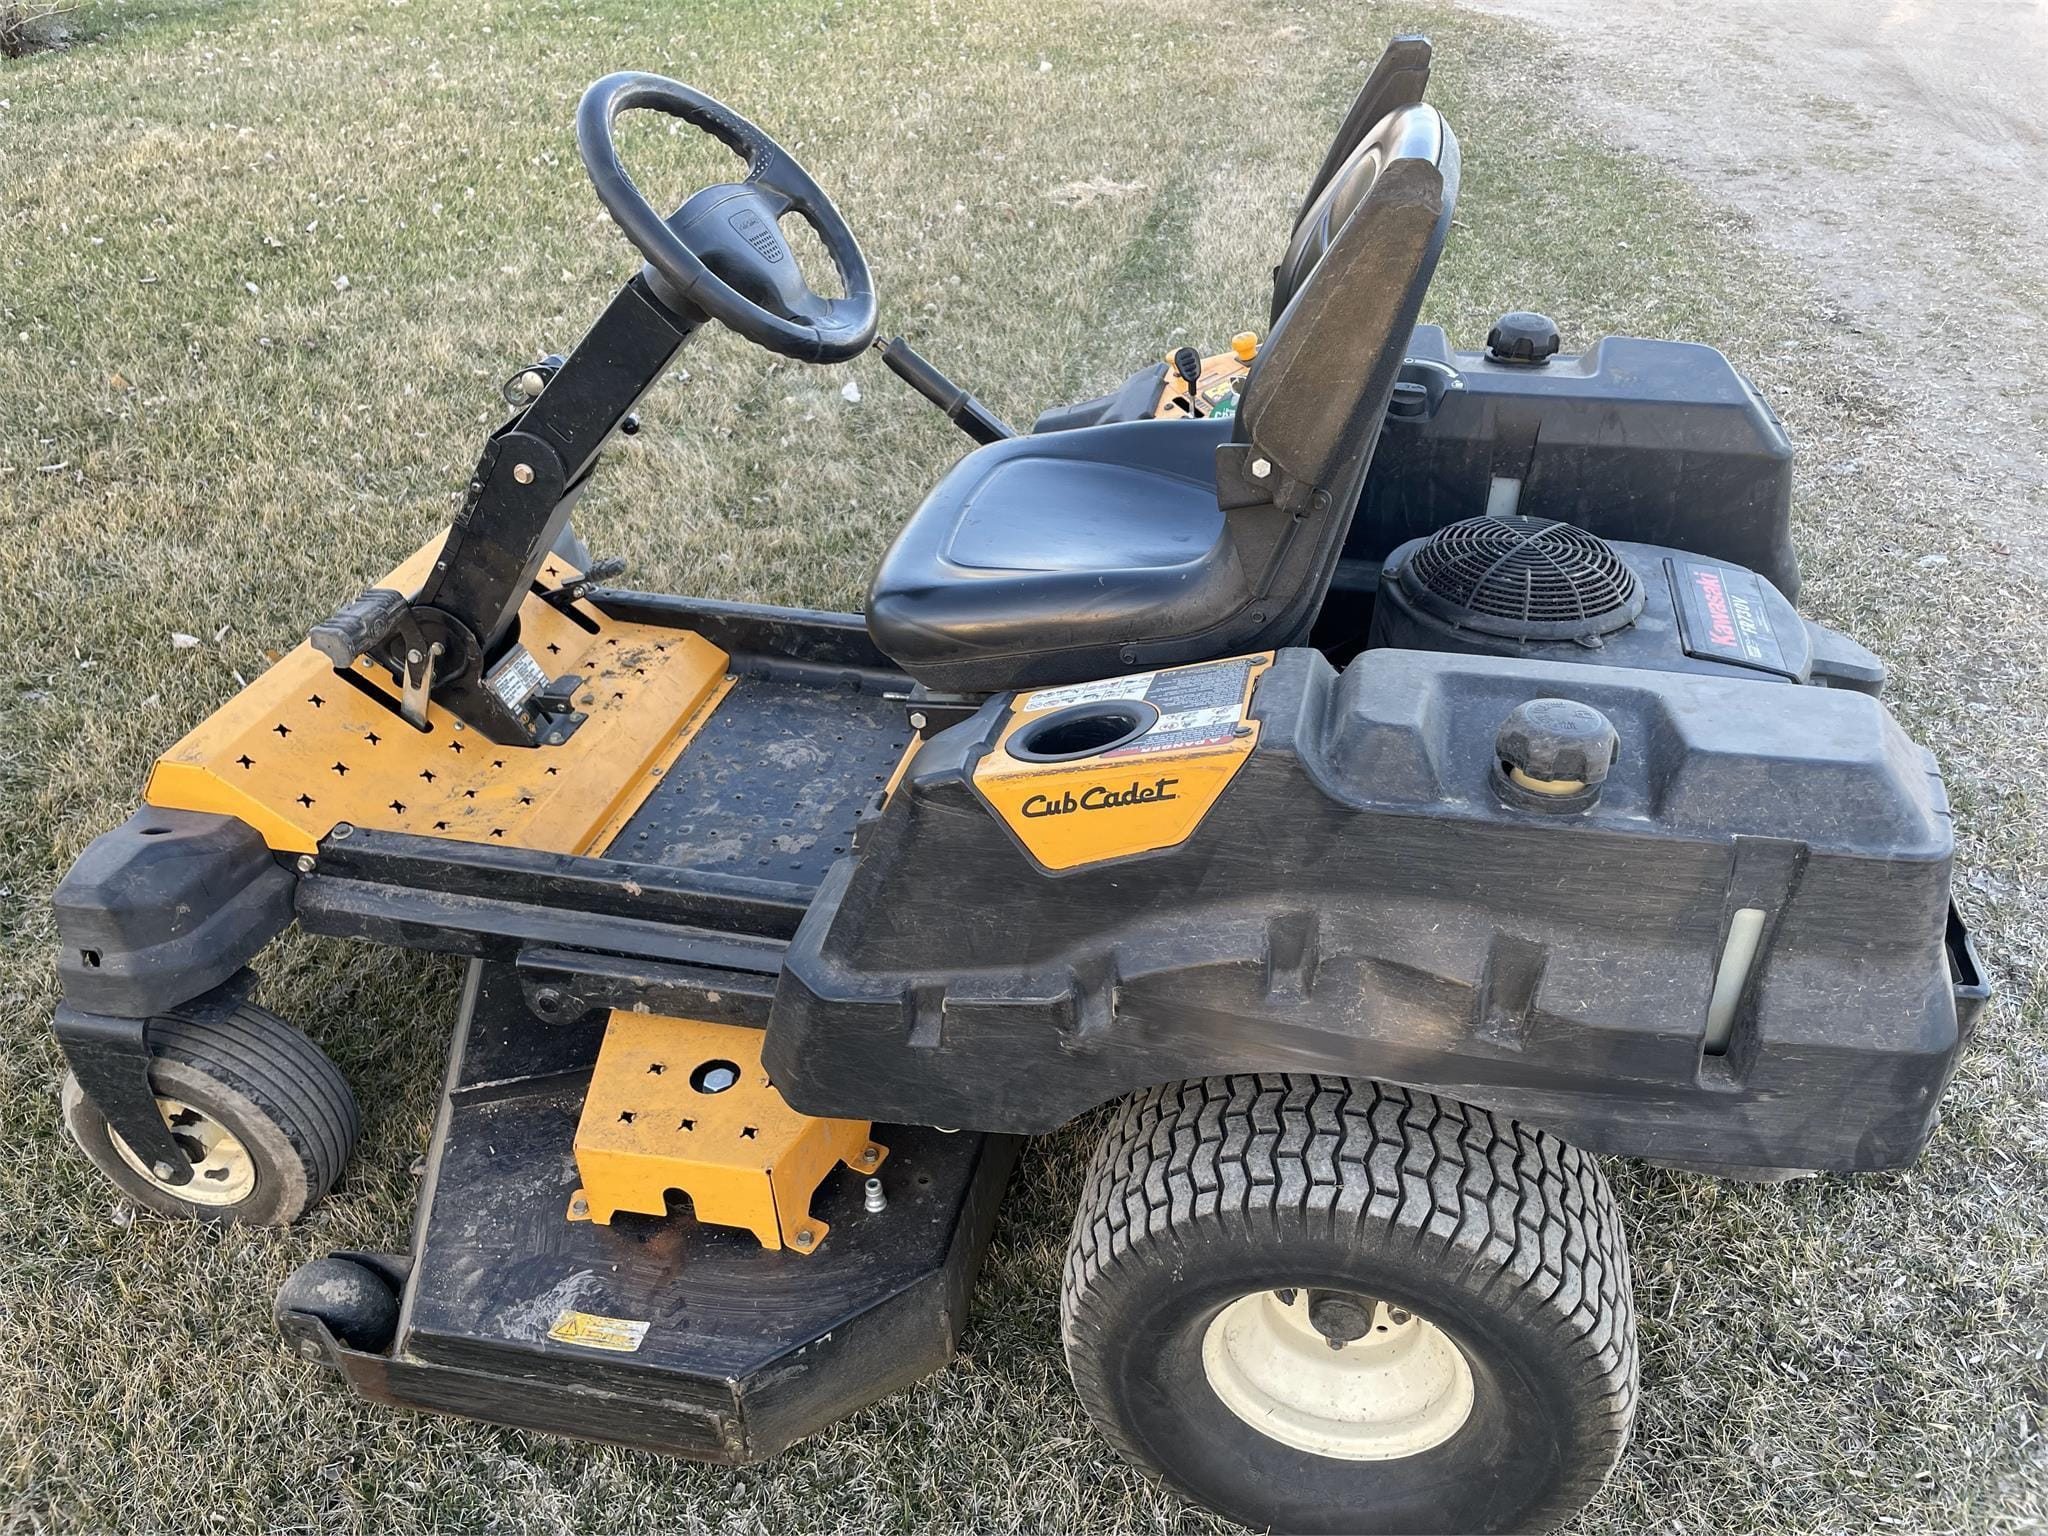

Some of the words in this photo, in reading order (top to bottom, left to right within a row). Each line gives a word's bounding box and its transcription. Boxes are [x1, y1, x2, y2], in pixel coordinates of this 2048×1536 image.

[1693, 571, 1737, 647] Kawasaki
[1140, 739, 1205, 753] DANGER
[1021, 791, 1077, 818] Cub
[1080, 778, 1179, 810] Cadet
